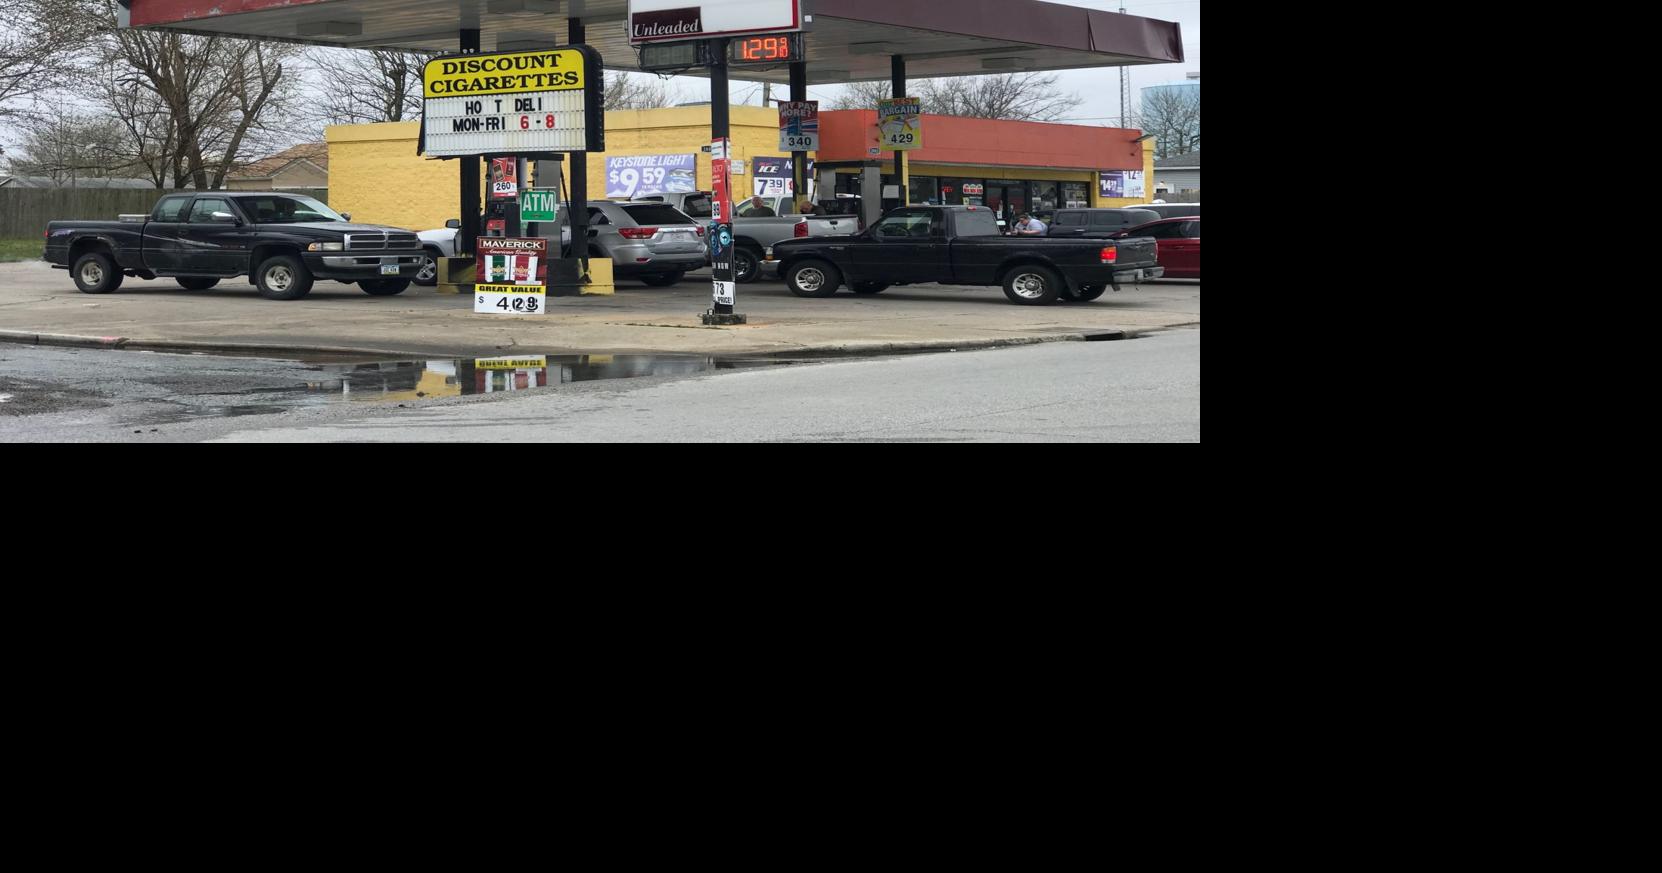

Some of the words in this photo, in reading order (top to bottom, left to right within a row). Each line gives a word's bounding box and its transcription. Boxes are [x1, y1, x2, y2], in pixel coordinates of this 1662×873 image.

[634, 19, 699, 38] Unleaded
[442, 54, 562, 75] DISCOUNT
[430, 71, 579, 94] CIGARETTES
[514, 97, 542, 112] DELI
[798, 102, 817, 111] PAY
[880, 105, 917, 117] BARGAIN
[453, 117, 505, 132] MON-FRI
[788, 136, 812, 146] 340
[891, 133, 914, 143] 429
[610, 156, 657, 168] KEYSTONE
[658, 155, 689, 166] LIGHT
[758, 165, 780, 173] ICE
[496, 182, 511, 191] 260
[522, 193, 554, 211] ATM
[482, 240, 541, 248] MAVERICK
